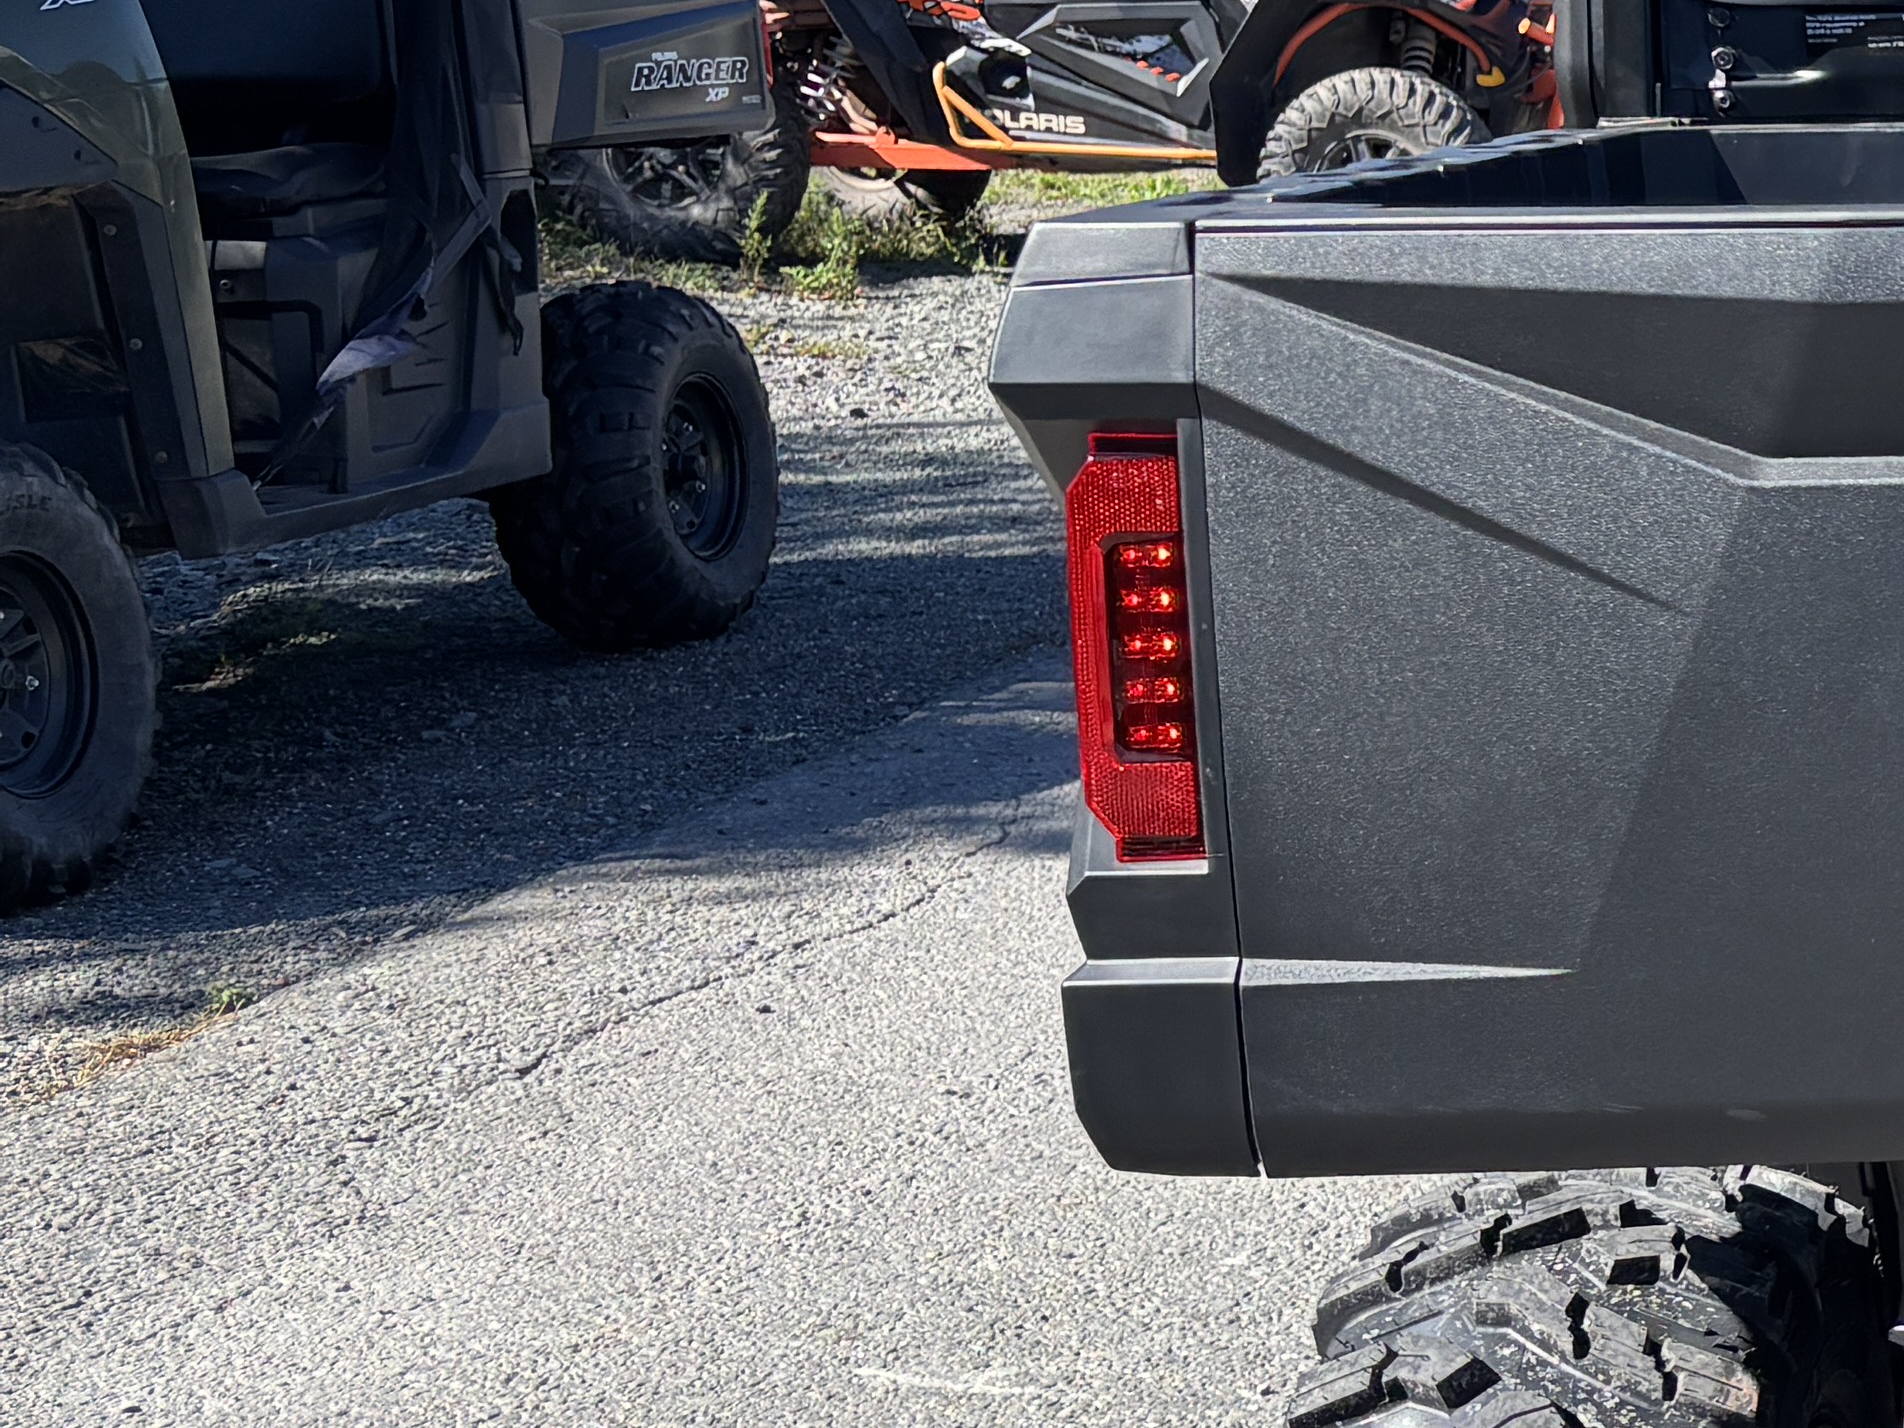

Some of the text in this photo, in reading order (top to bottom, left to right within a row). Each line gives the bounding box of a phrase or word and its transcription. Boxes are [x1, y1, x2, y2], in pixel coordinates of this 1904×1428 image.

[631, 56, 749, 91] RANGER
[705, 87, 730, 103] XP
[984, 109, 1086, 134] OLARIS
